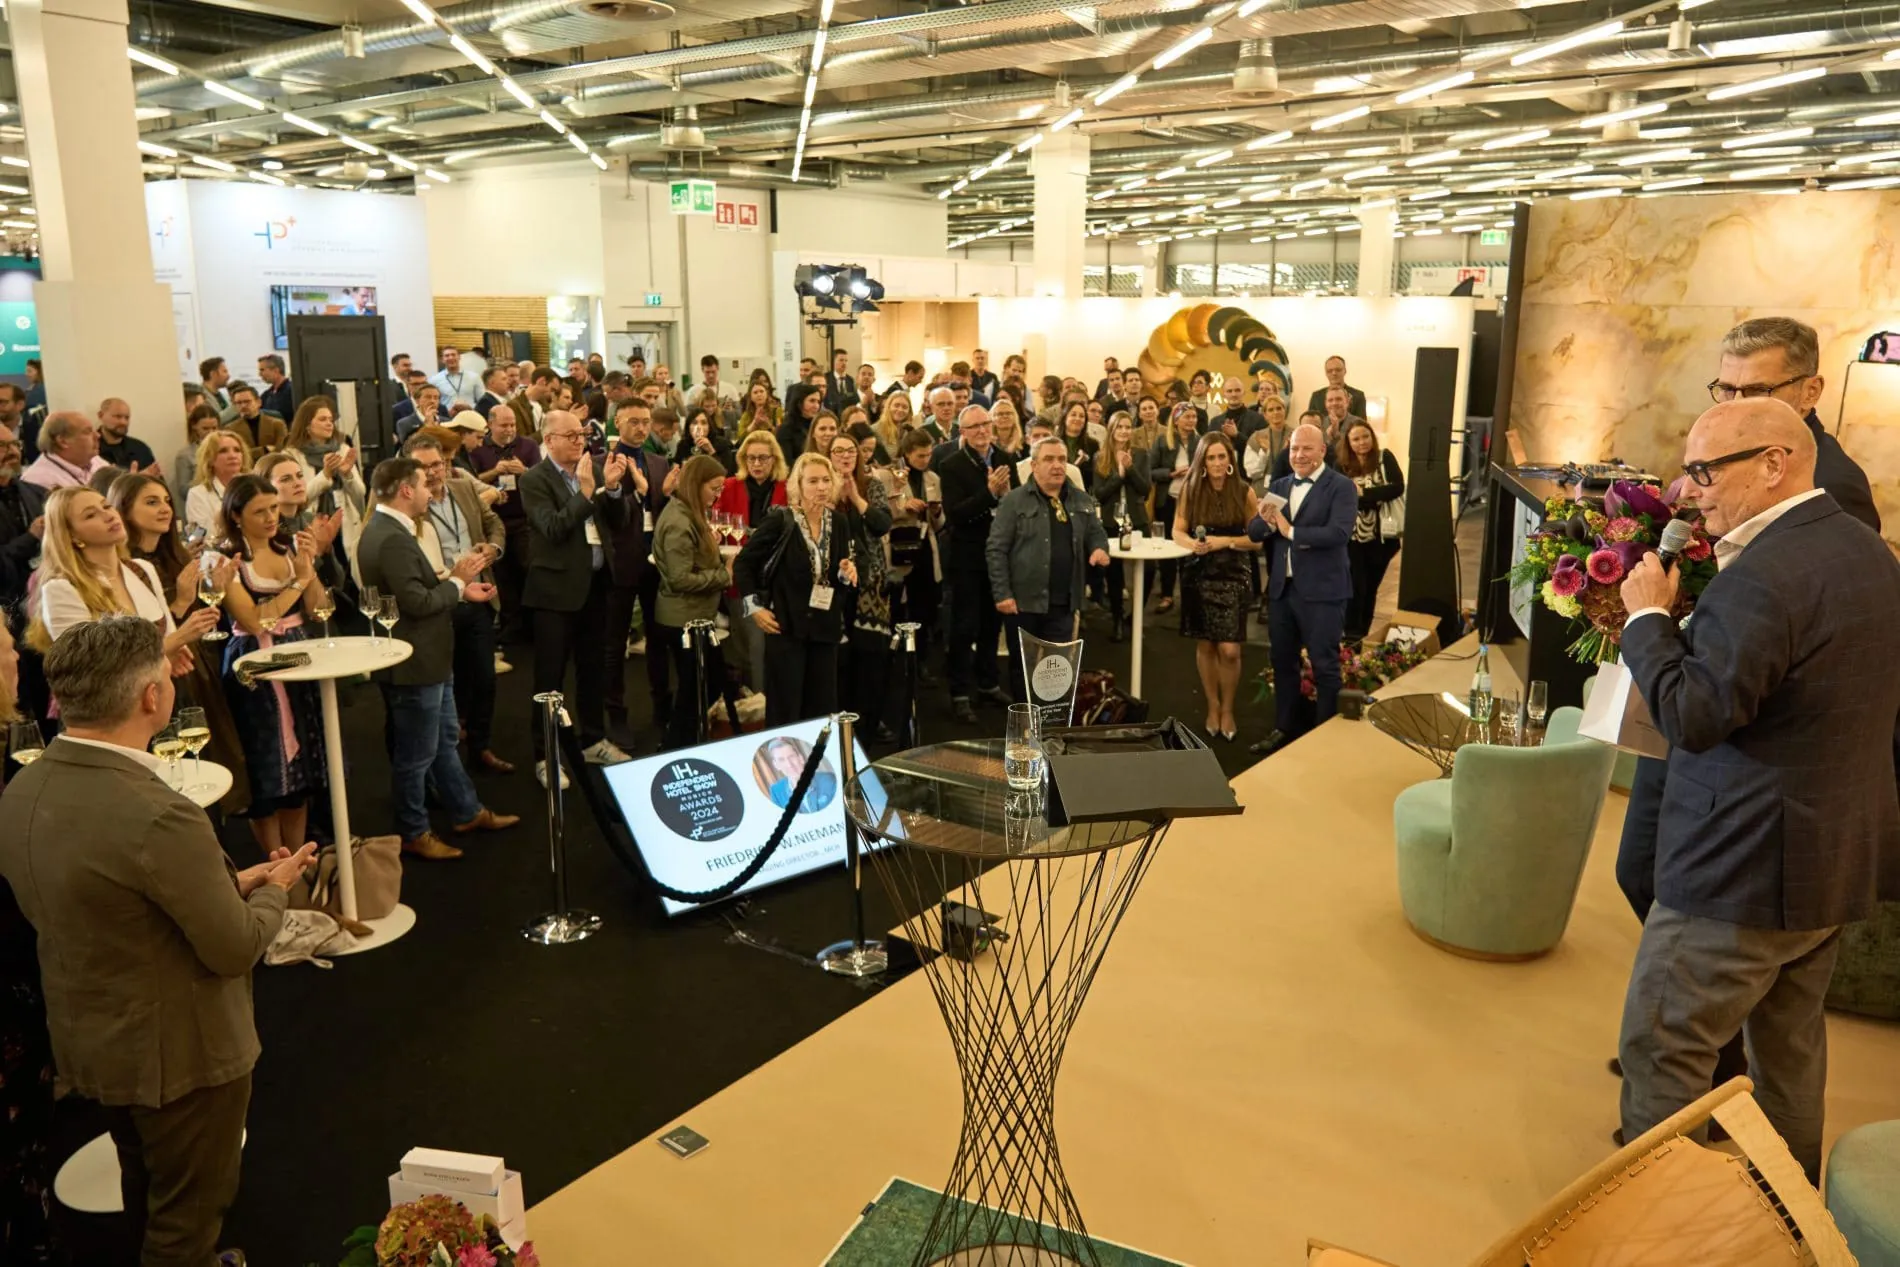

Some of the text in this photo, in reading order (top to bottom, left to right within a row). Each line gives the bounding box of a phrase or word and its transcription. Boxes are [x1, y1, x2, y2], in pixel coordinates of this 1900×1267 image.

[671, 762, 699, 780] IH.
[662, 772, 715, 792] INDEPENDENT
[666, 780, 717, 799] HOTEL SHOW
[679, 794, 723, 813] AWARDS
[681, 790, 713, 801] MUNICH
[690, 806, 719, 820] 2024
